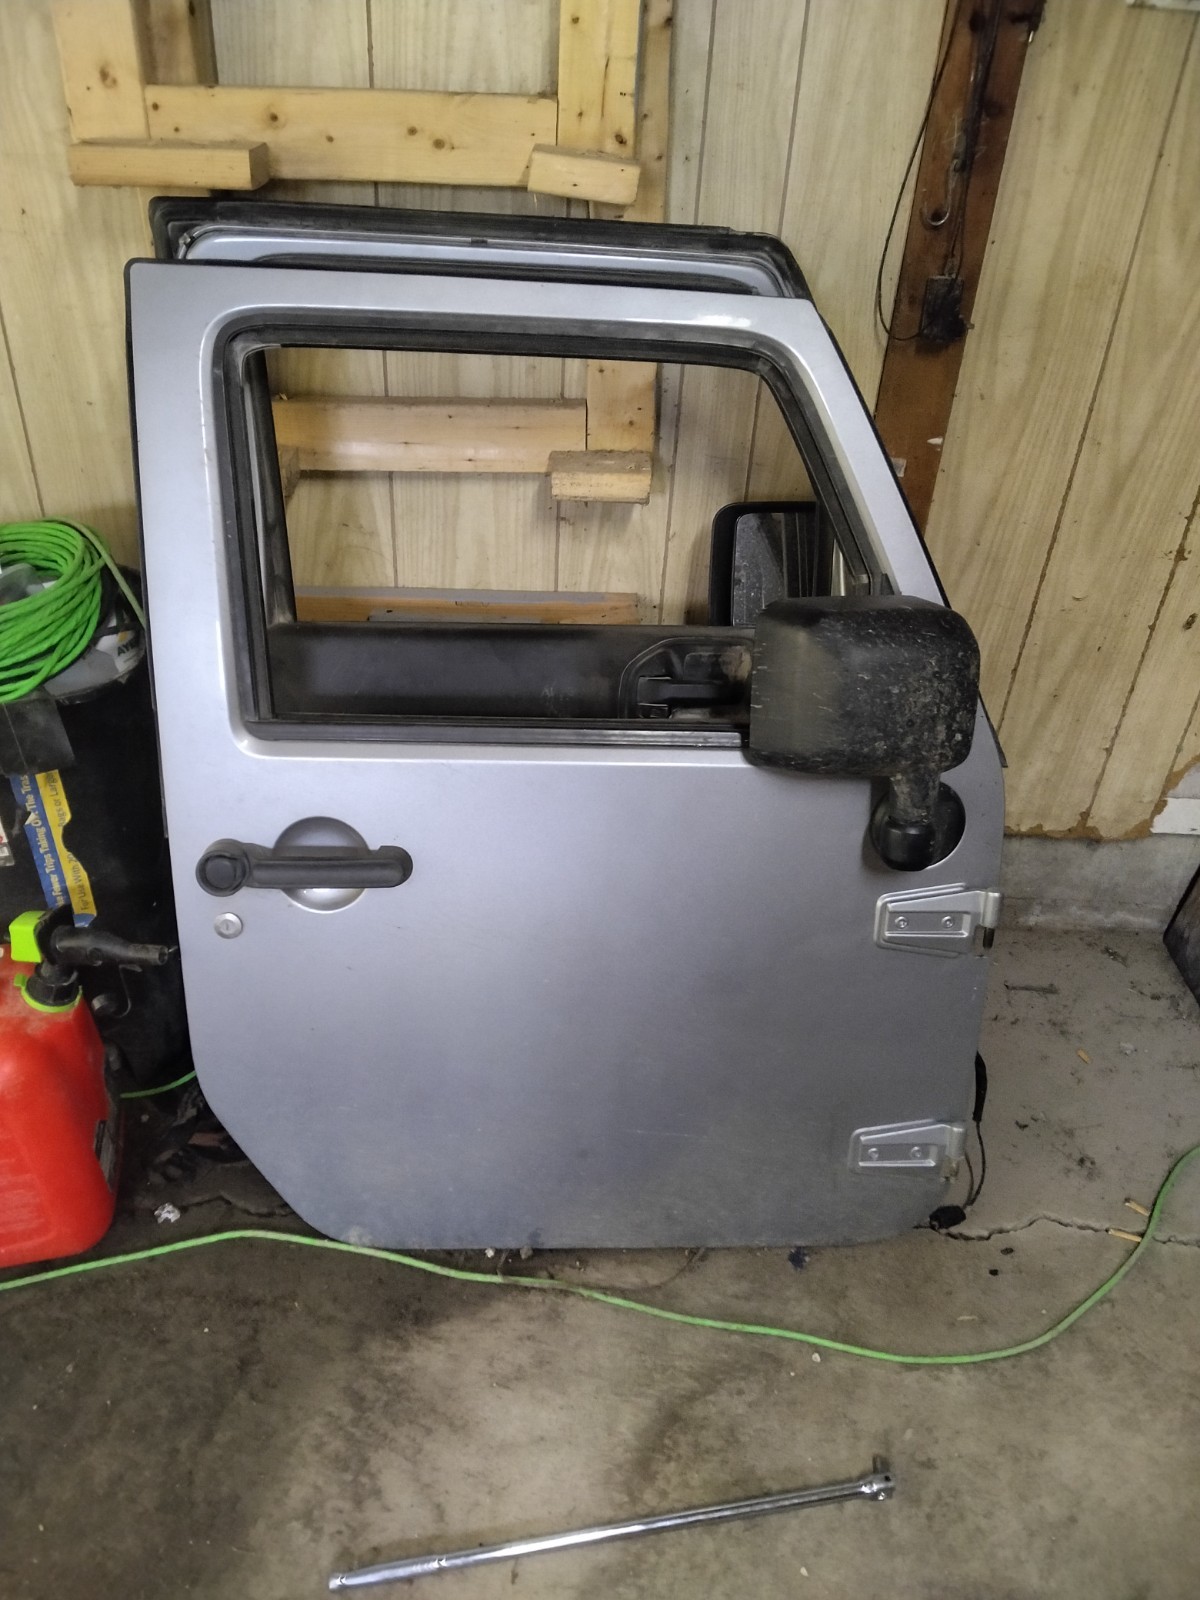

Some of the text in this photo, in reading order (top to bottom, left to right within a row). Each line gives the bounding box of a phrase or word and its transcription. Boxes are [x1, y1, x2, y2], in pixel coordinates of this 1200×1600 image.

[21, 774, 32, 794] Tras
[25, 794, 36, 811] The
[54, 798, 62, 807] or
[36, 826, 50, 854] Taking
[44, 853, 56, 874] Trips
[72, 863, 82, 886] With
[51, 874, 62, 896] Fewer
[77, 884, 86, 899] Use
[80, 898, 89, 911] For
